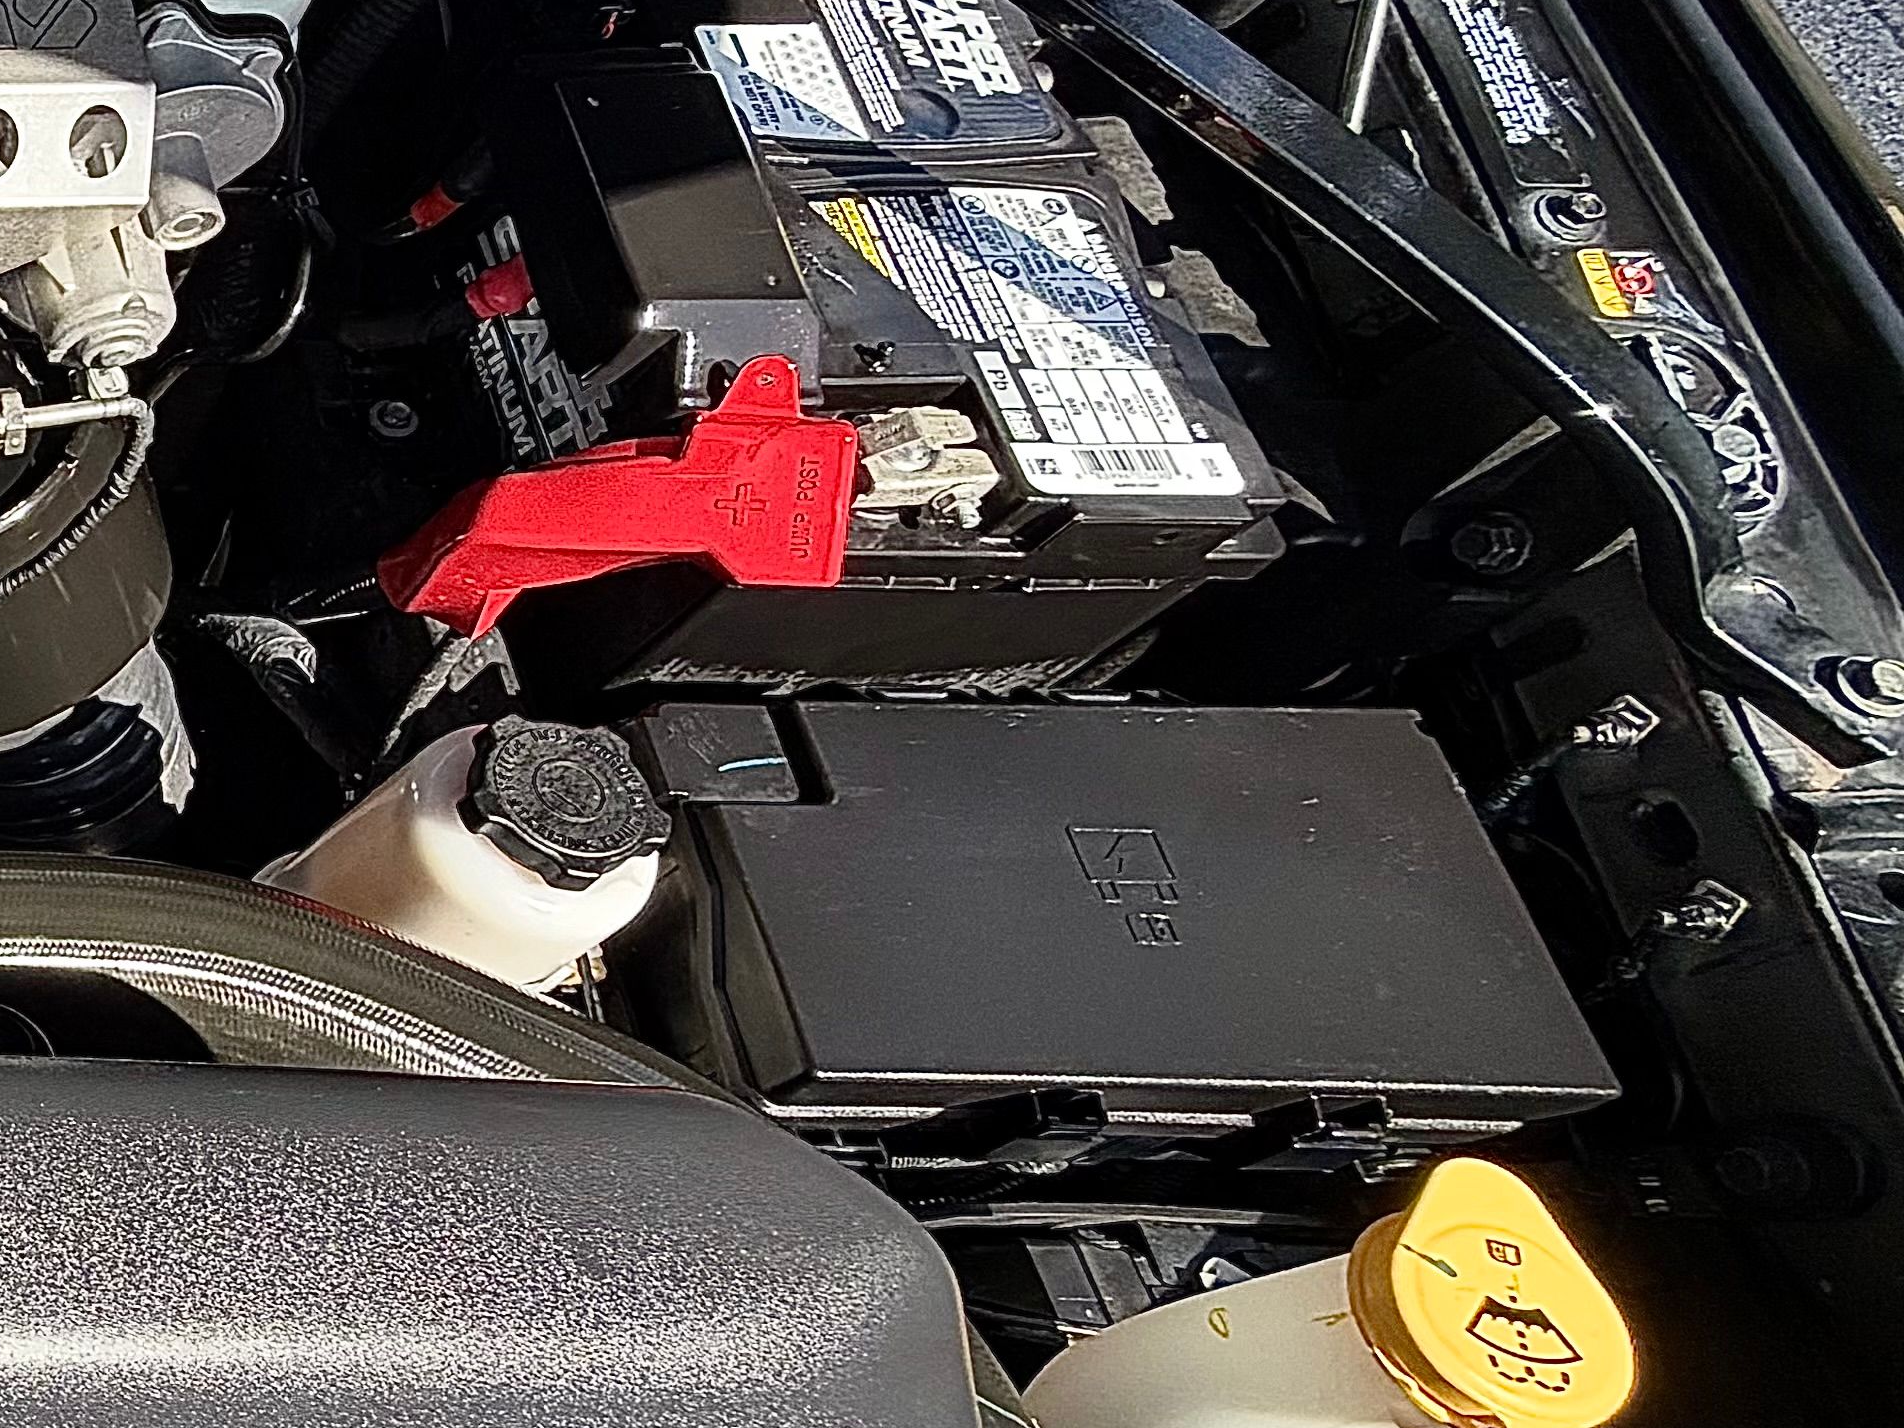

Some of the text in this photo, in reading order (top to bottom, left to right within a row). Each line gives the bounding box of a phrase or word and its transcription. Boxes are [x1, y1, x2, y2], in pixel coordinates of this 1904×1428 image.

[477, 214, 590, 451] SART
[987, 369, 1009, 391] Pb
[791, 456, 821, 559] JUMP POST
